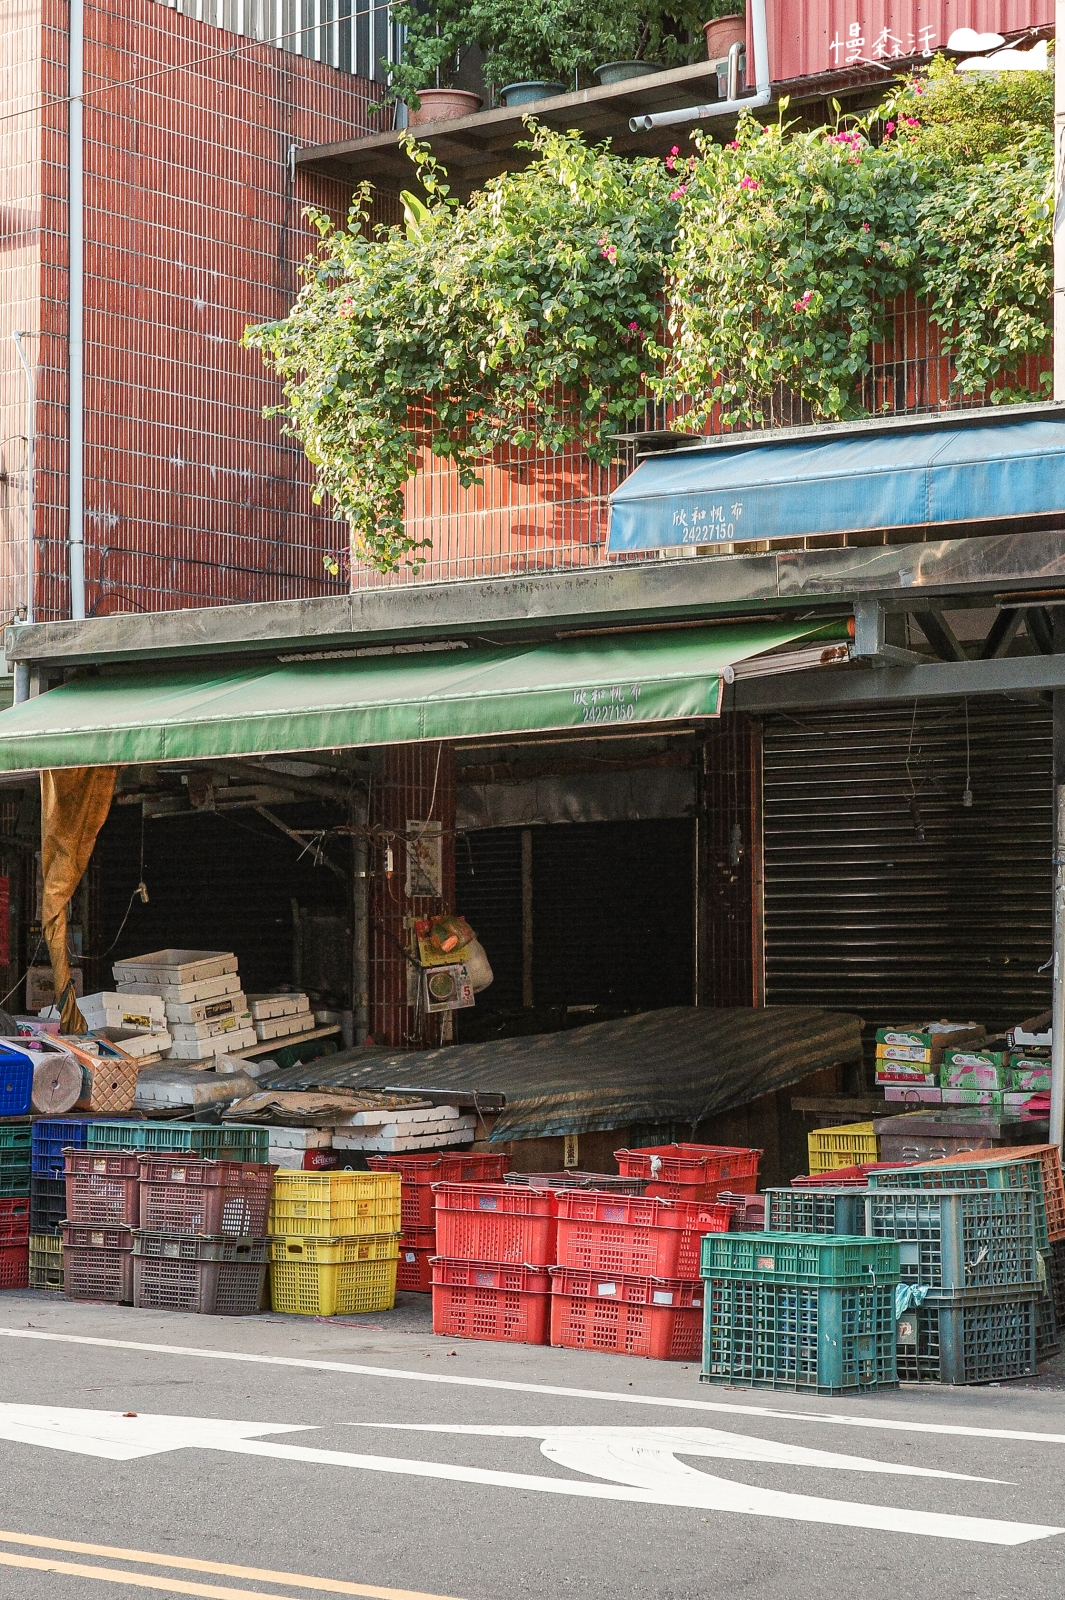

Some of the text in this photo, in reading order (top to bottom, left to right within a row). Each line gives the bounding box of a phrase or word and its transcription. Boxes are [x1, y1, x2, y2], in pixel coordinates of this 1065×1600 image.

[672, 501, 743, 526] 欣和帆布
[682, 523, 734, 543] 24227150
[572, 682, 643, 706] 欣和帆布
[582, 703, 634, 723] 24227150
